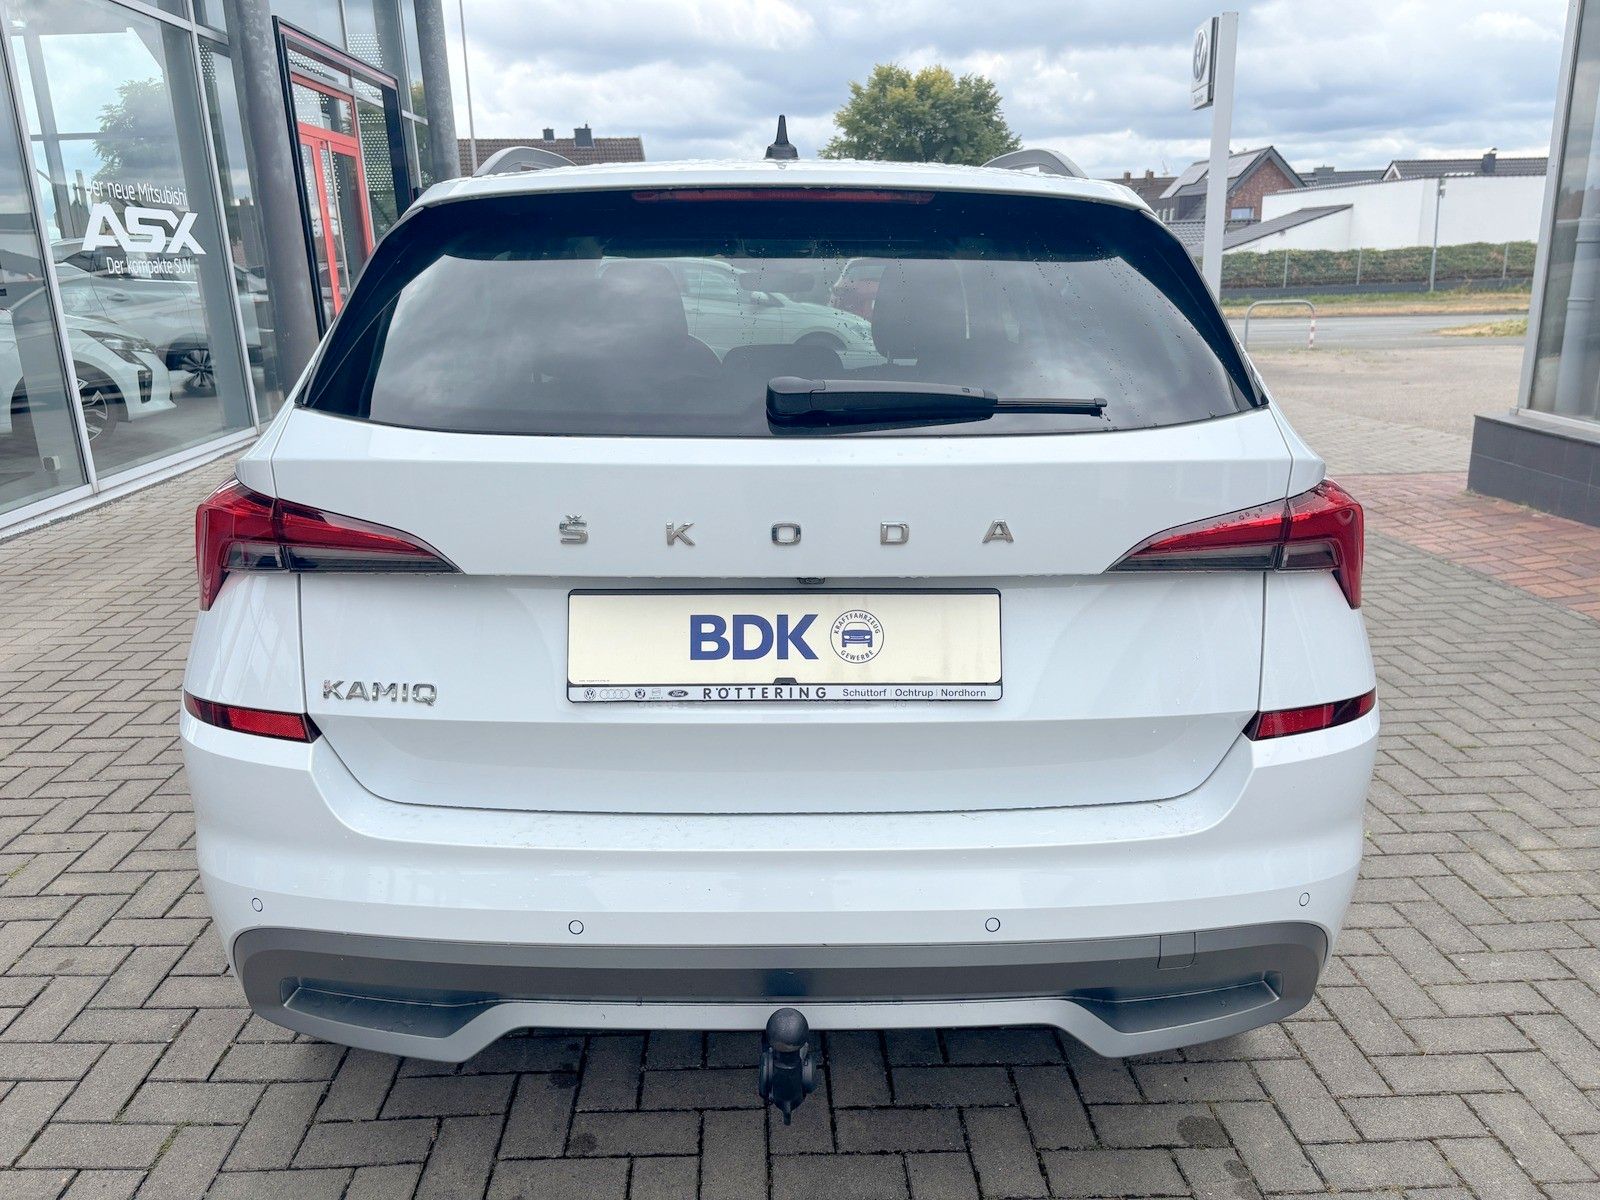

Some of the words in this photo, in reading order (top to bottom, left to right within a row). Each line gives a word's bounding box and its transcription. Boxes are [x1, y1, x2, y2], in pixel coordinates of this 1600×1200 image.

[107, 182, 135, 201] neue
[137, 182, 188, 206] Mitsubishi
[82, 201, 207, 255] ASX
[106, 256, 124, 274] Der
[126, 257, 173, 278] kompakte
[174, 258, 192, 274] SUV
[834, 612, 881, 635] KRAFTFAHRZEUG
[690, 614, 819, 661] BDK
[840, 650, 874, 661] GEWERBE
[322, 679, 438, 706] KAMIQ
[703, 687, 827, 699] RÖTTERING
[894, 688, 934, 699] Ochtrup
[941, 688, 987, 697] Nordhorn
